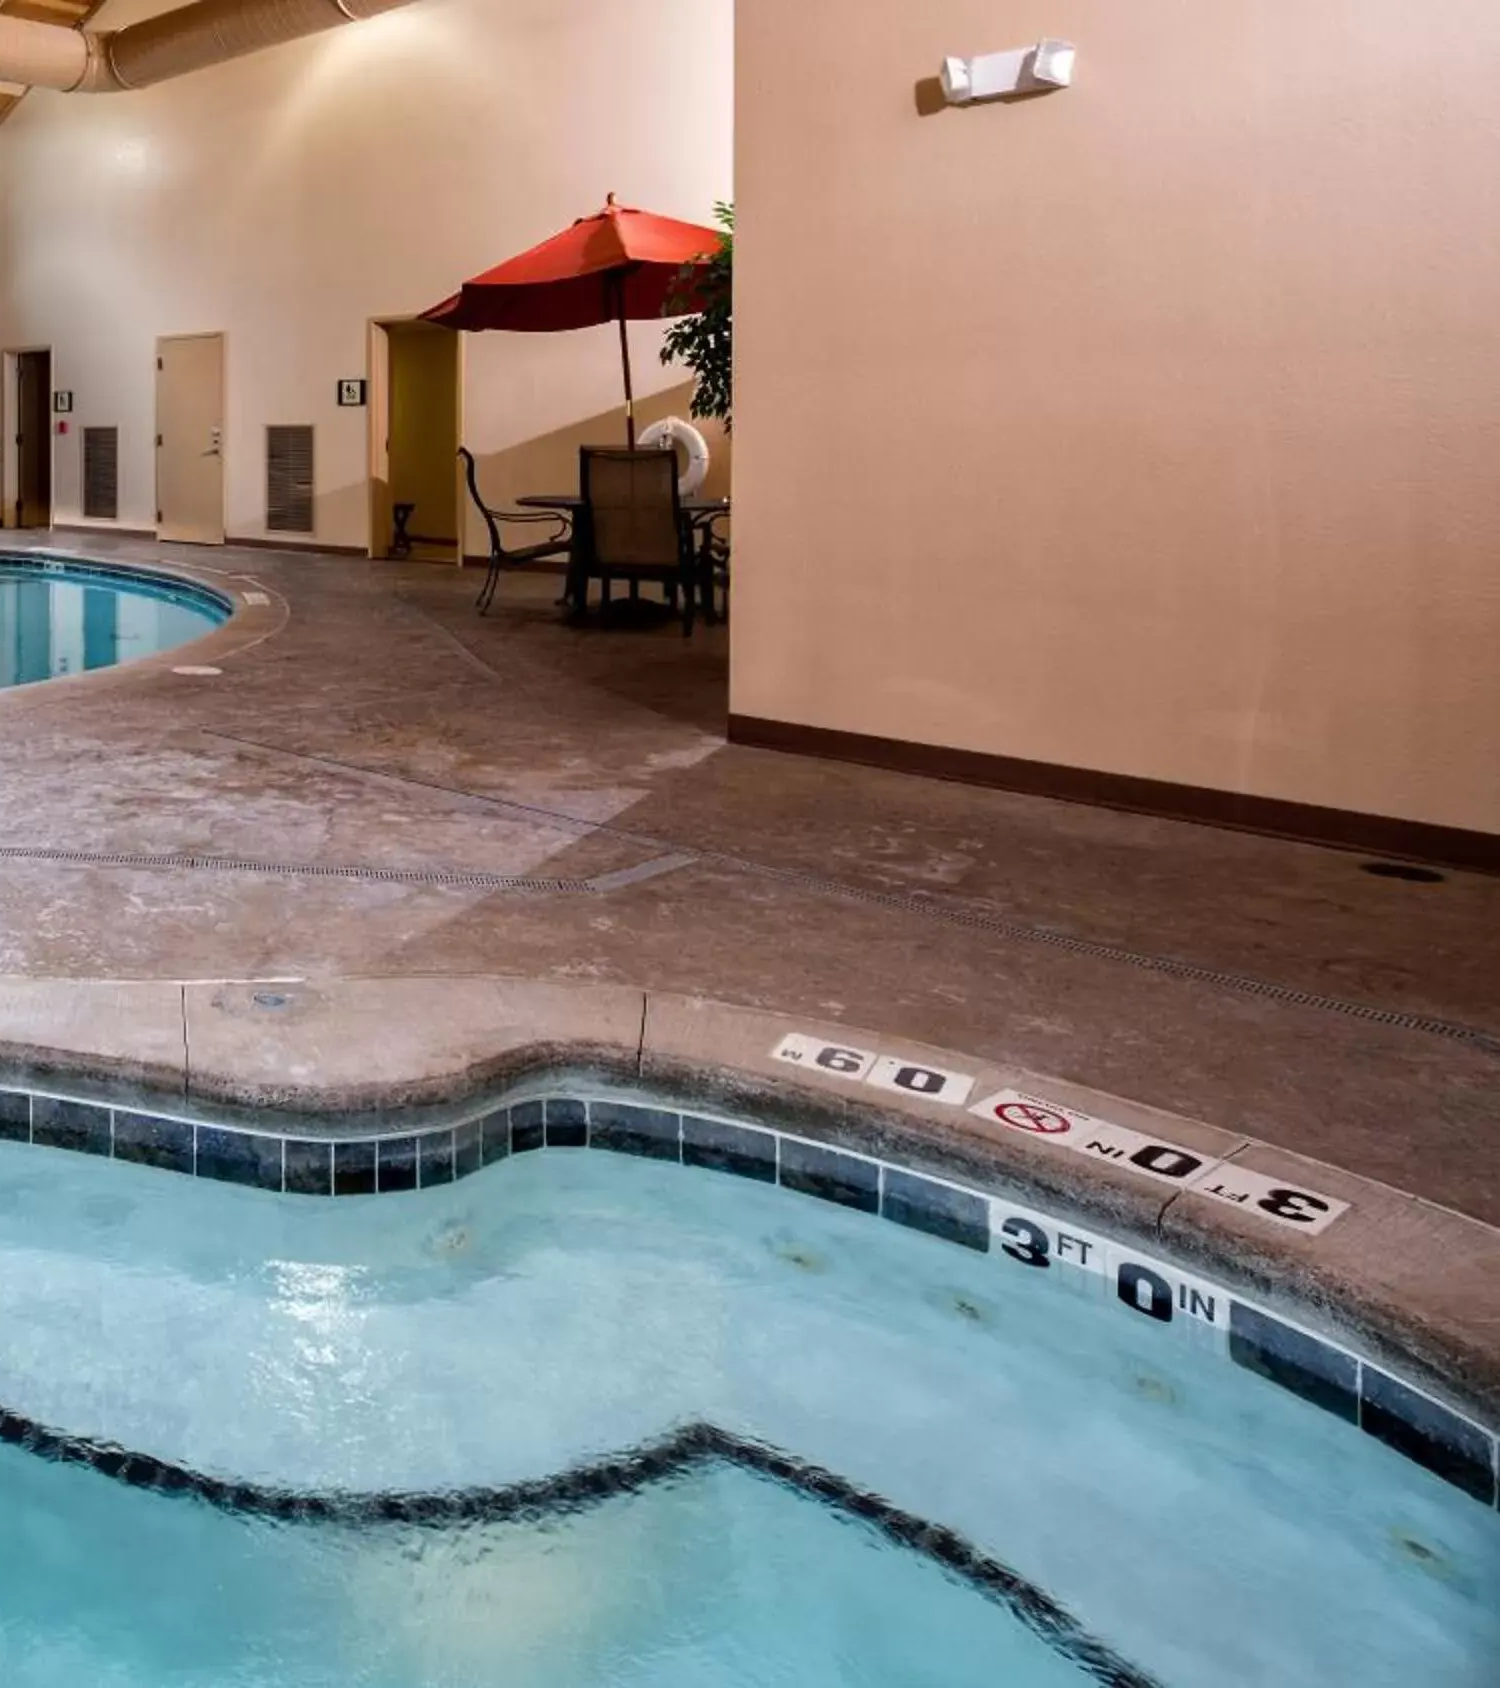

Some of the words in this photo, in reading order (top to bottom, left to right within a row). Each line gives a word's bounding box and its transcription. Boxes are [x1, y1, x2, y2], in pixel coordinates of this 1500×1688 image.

[1086, 1141, 1125, 1159] IN
[1130, 1145, 1203, 1178] 0
[1203, 1184, 1250, 1203] FT
[1257, 1189, 1329, 1223] 3
[1001, 1217, 1050, 1268] 3
[1057, 1232, 1093, 1265] FT
[1117, 1262, 1174, 1322] 0
[1178, 1284, 1215, 1322] IN
